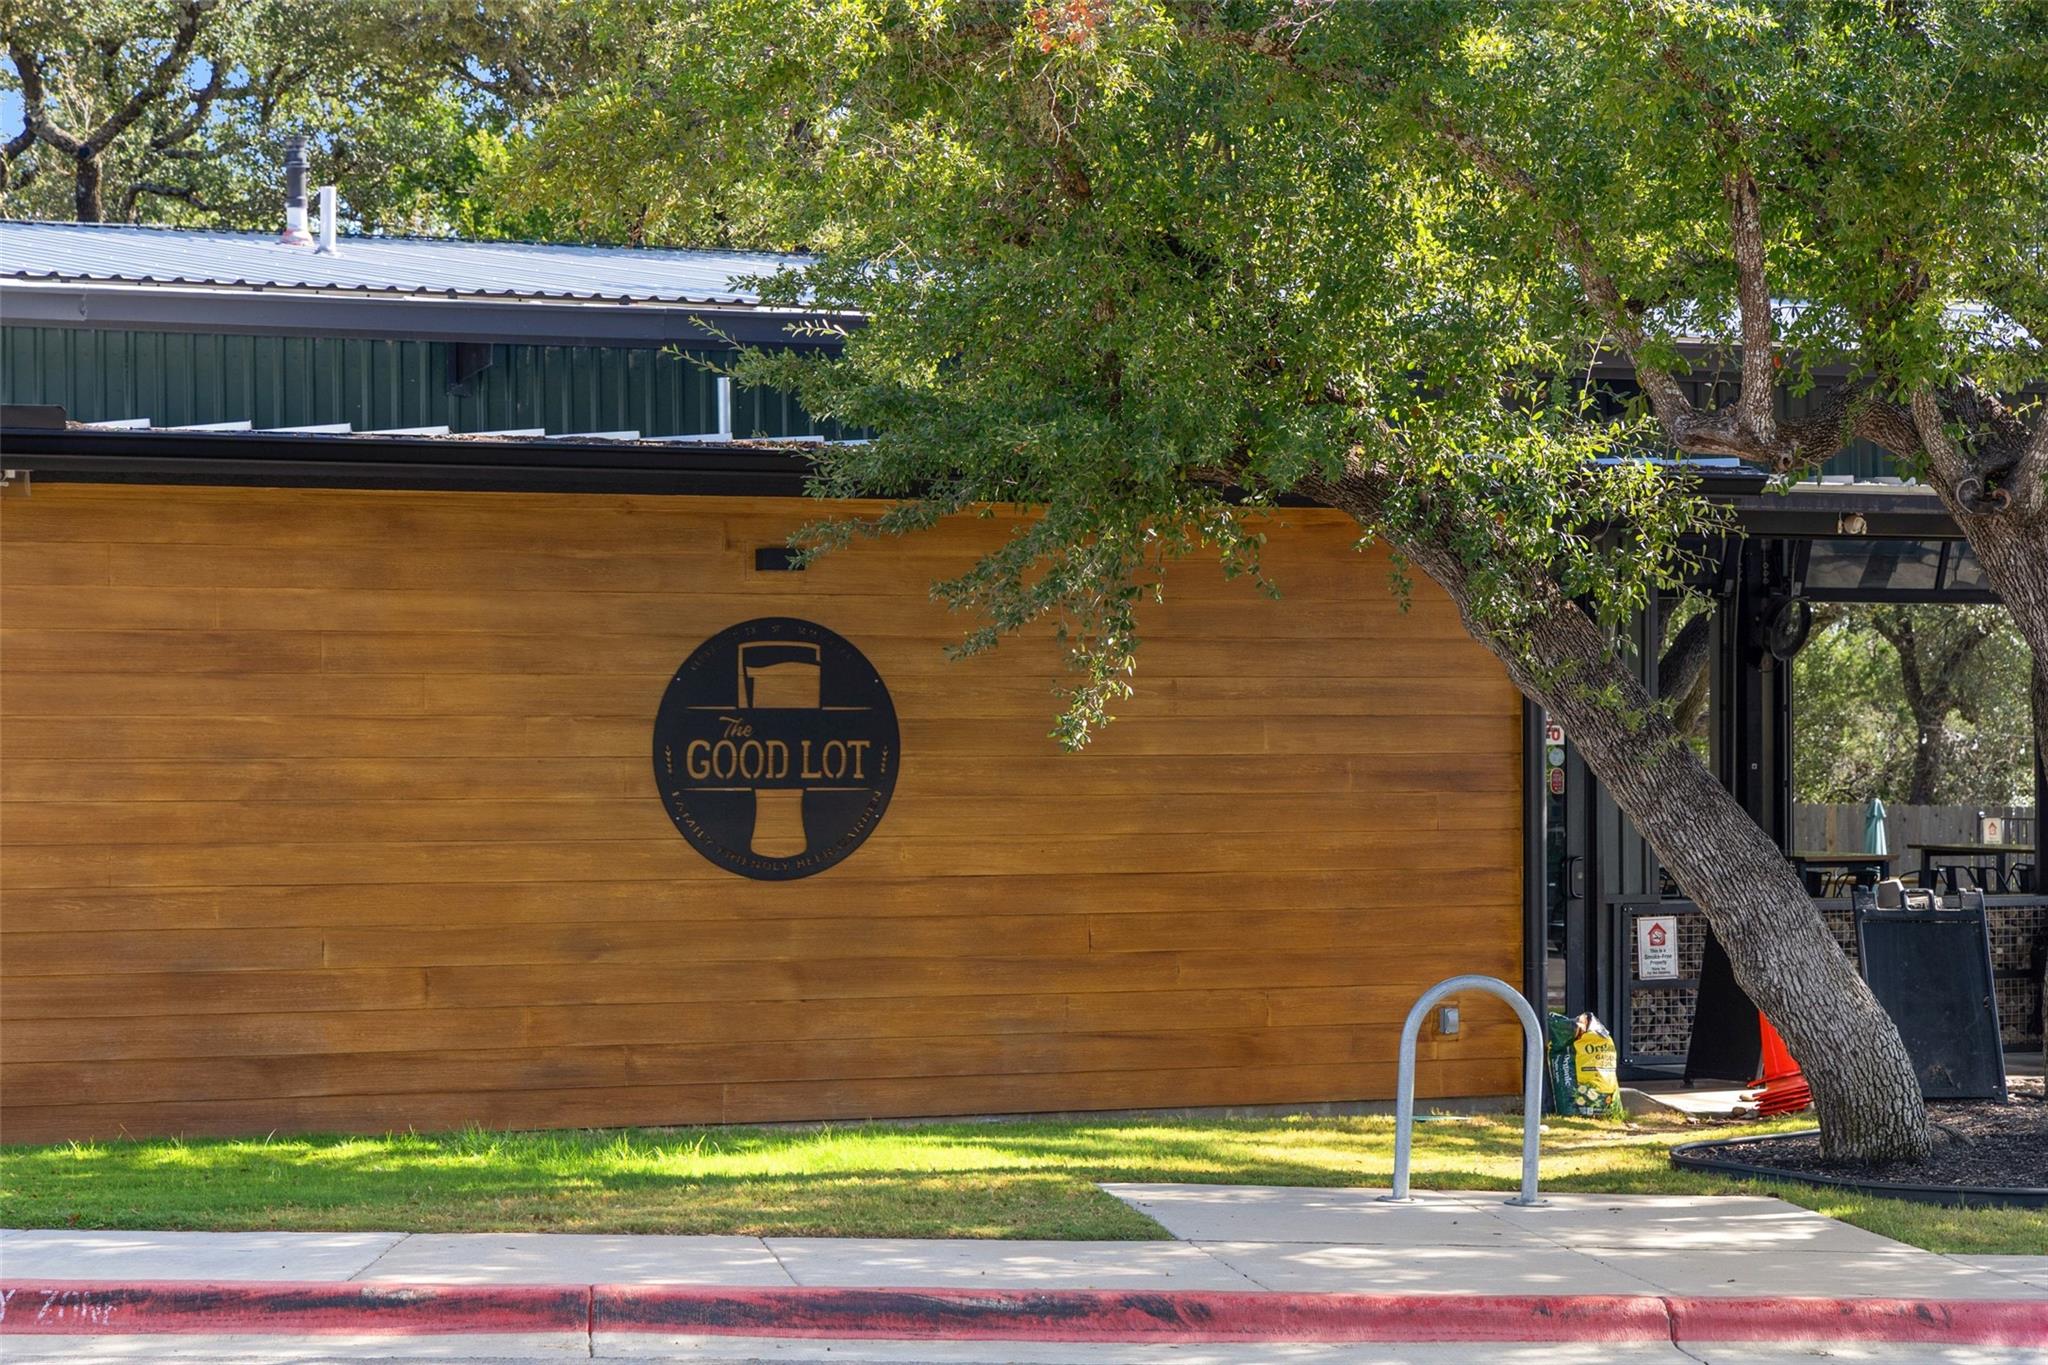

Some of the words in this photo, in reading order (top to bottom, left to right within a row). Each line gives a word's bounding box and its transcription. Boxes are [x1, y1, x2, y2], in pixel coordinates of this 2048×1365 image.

[719, 716, 753, 738] The
[686, 739, 789, 779] GOOD
[800, 740, 870, 779] LOT
[672, 791, 713, 847] FAMILY
